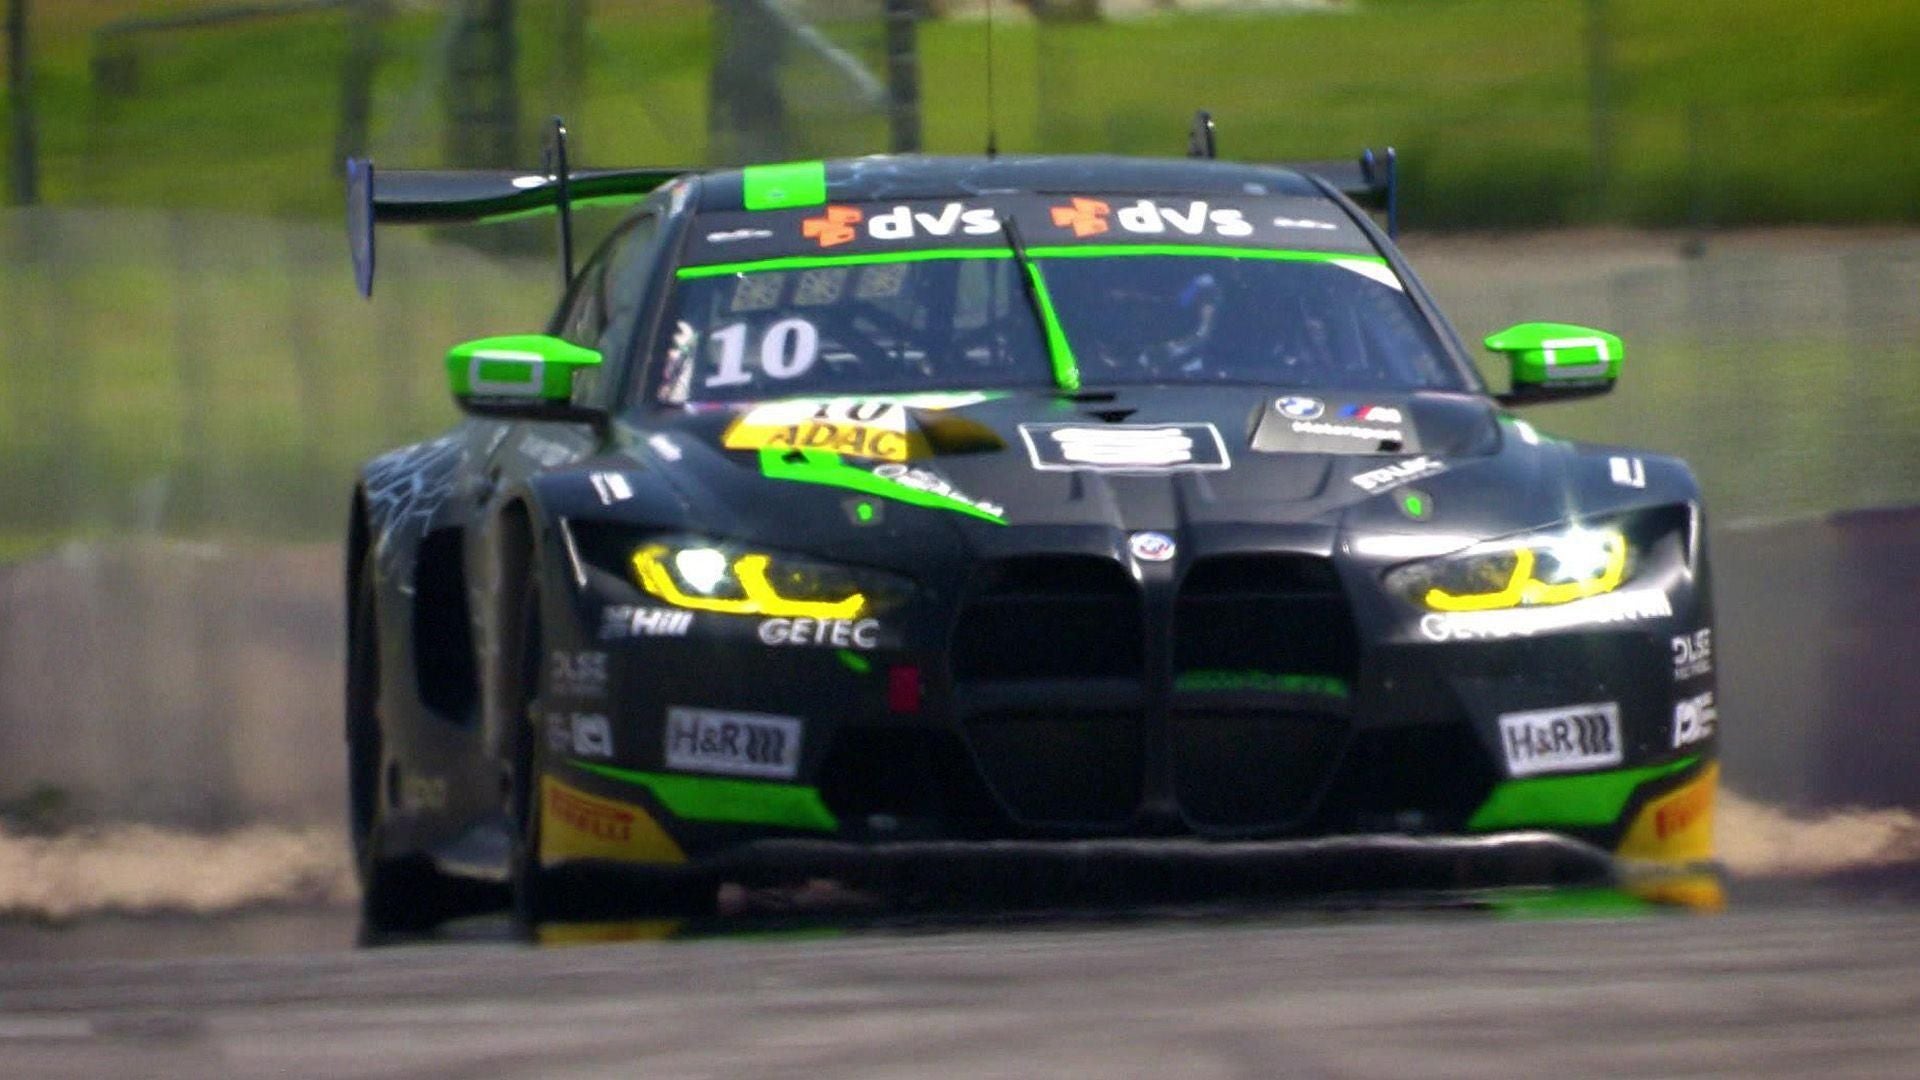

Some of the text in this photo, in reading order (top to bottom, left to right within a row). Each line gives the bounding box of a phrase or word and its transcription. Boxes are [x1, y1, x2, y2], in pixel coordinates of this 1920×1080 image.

[705, 318, 818, 388] 10
[768, 419, 905, 455] ADAC
[631, 607, 694, 636] Hill
[758, 618, 880, 648] GETEC
[671, 720, 739, 757] H&R
[1508, 719, 1575, 762] H&R
